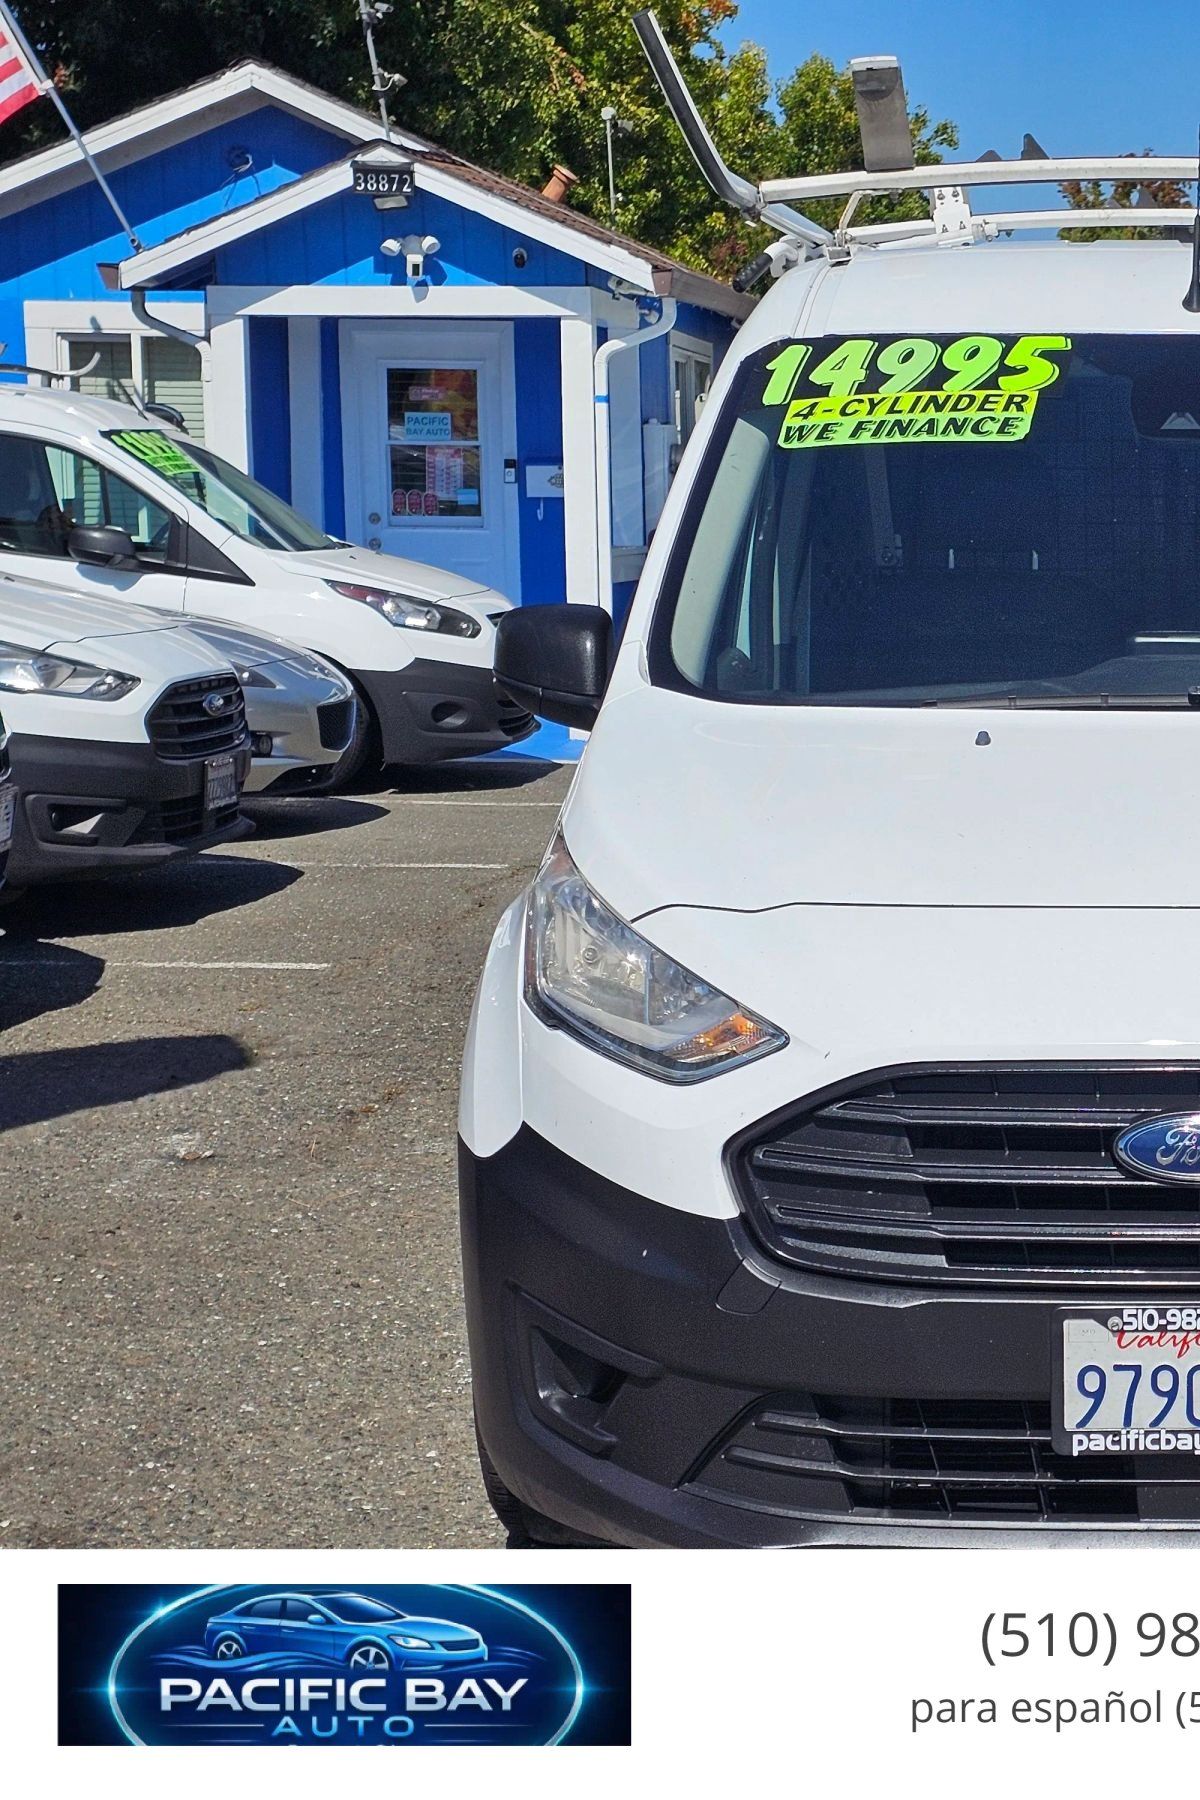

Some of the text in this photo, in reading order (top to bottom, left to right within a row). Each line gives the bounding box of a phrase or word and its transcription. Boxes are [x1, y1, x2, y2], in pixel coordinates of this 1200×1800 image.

[355, 172, 412, 193] 38872
[762, 336, 1072, 406] 14995
[792, 394, 1031, 420] 4-CYLINDER
[406, 428, 450, 436] BAY AUTO
[407, 416, 449, 426] PACIFIC
[784, 415, 1024, 444] WE FINANCE
